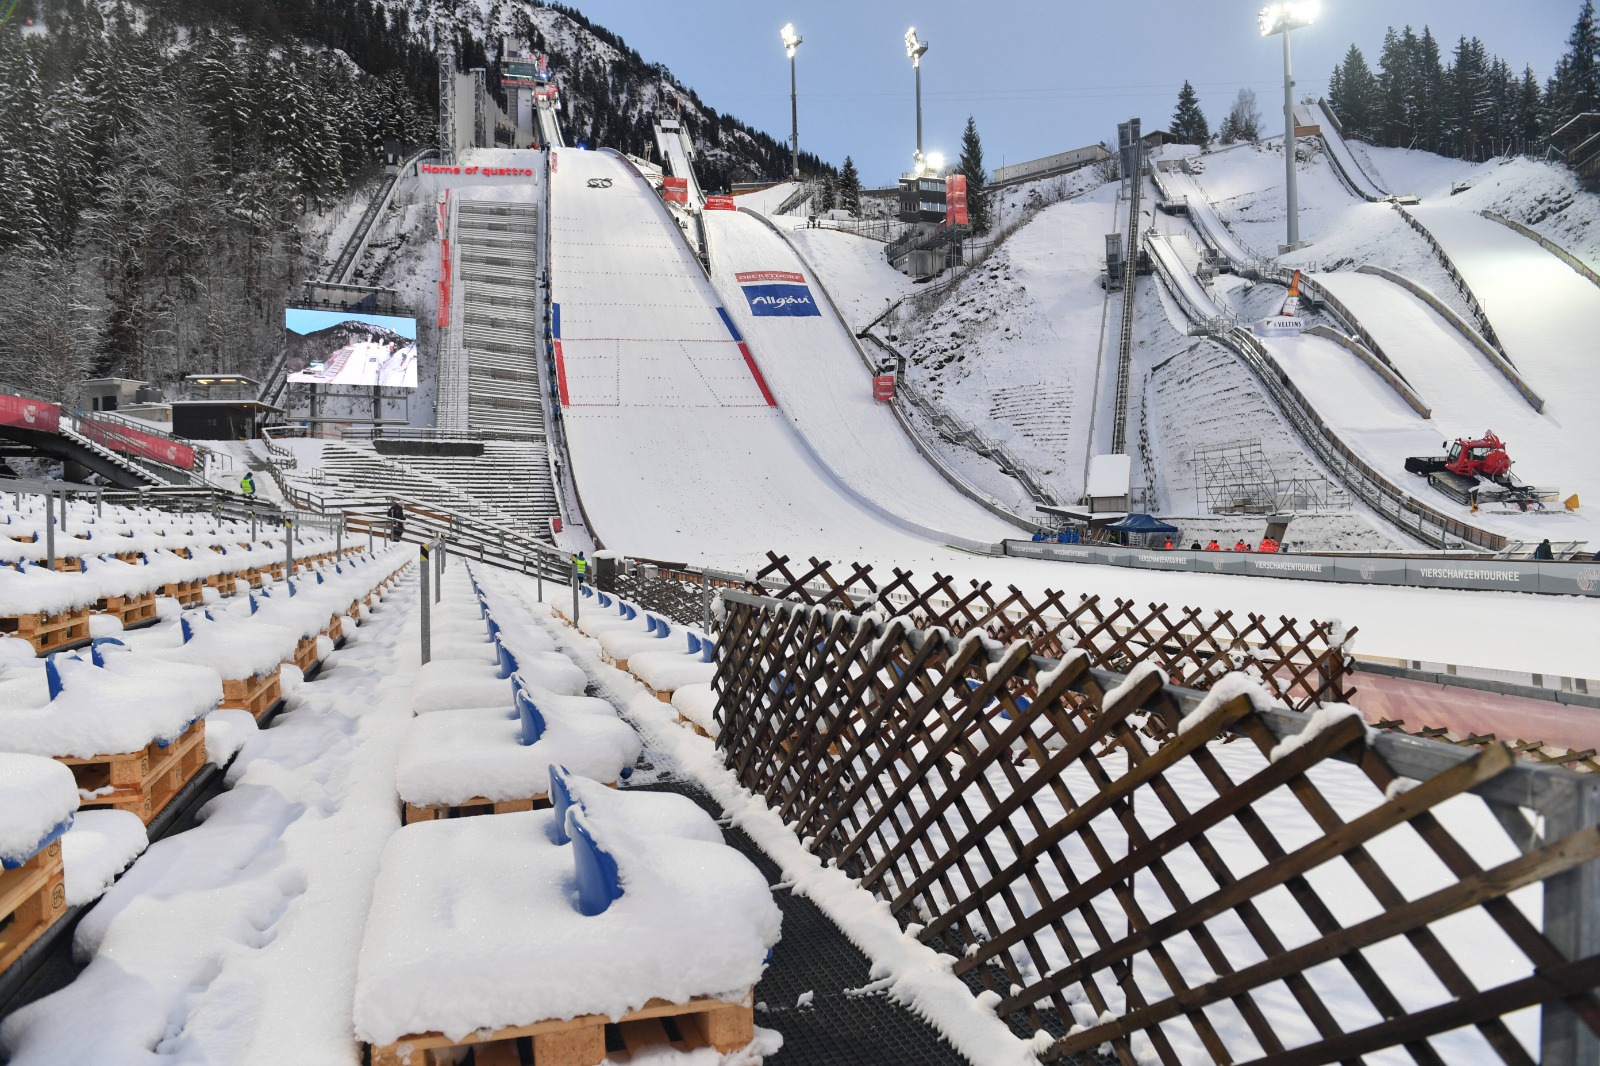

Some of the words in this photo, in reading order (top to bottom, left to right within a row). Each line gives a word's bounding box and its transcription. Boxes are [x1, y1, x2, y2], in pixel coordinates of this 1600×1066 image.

[421, 164, 460, 174] Home
[464, 166, 479, 175] of
[481, 167, 533, 177] quattro
[752, 296, 810, 308] Allgäu
[1254, 560, 1322, 573] VIERSCHANZENTOURNEE
[1420, 568, 1520, 582] VIERSCHANZENTOURNEE
